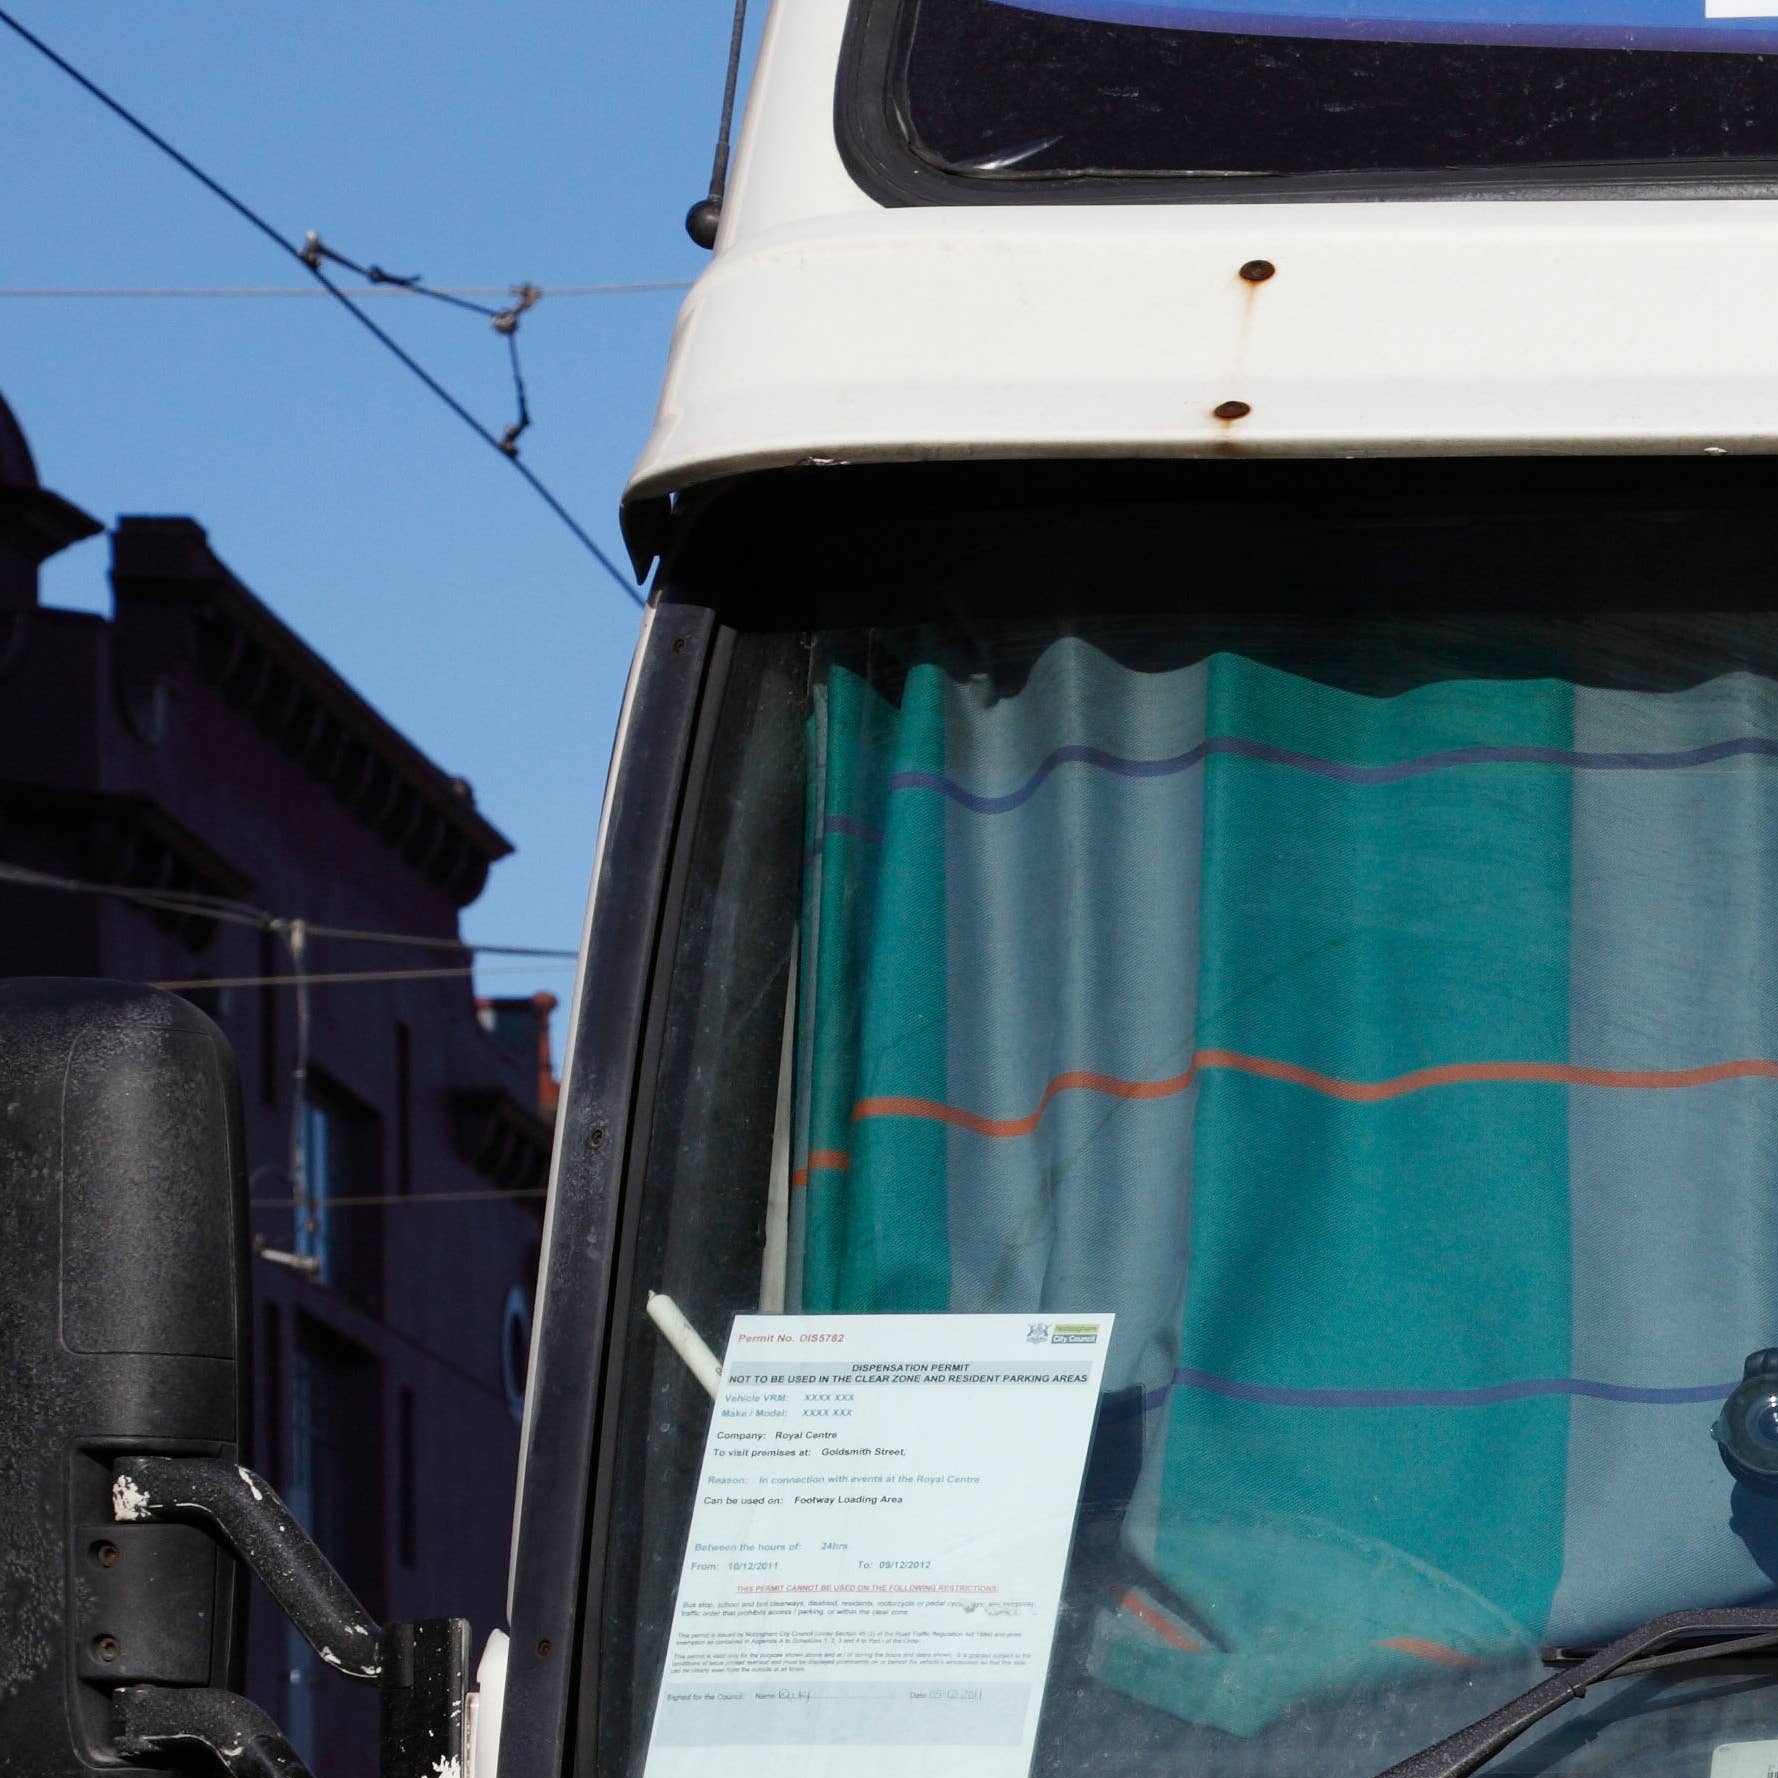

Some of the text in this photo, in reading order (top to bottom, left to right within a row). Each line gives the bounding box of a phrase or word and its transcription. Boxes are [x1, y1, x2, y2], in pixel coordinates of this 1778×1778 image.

[738, 1333, 774, 1343] Permit
[1053, 1334, 1096, 1343] City Council
[852, 1363, 970, 1372] DISPENSATION PERMIT
[729, 1375, 1088, 1384] NOT TO BE USED IN THE CLEAR ZONE AND RESIDENT PARKING AREAS
[716, 1431, 838, 1441] Company: Royal Centre
[713, 1448, 725, 1458] To
[729, 1448, 749, 1458] visit
[751, 1448, 796, 1458] premises
[821, 1448, 872, 1458] Goldsmith
[760, 1475, 768, 1484] In
[771, 1475, 825, 1484] connection
[828, 1475, 848, 1484] with
[850, 1475, 882, 1484] events
[886, 1475, 896, 1484] at
[898, 1475, 914, 1484] the
[917, 1475, 944, 1484] Royal
[947, 1475, 980, 1484] Centre
[704, 1496, 723, 1505] Can
[726, 1496, 738, 1505] be
[741, 1496, 765, 1505] used
[794, 1496, 835, 1505] Footway
[838, 1496, 878, 1505] Loading
[880, 1496, 904, 1505] Area
[694, 1543, 737, 1551] Between
[739, 1543, 755, 1551] the
[758, 1543, 786, 1551] hours
[857, 1561, 873, 1570] To:
[737, 1584, 754, 1592] THIS
[756, 1584, 784, 1592] PERMIT
[786, 1584, 818, 1592] CANNOT
[821, 1584, 832, 1592] BE
[834, 1584, 855, 1592] USED
[857, 1584, 870, 1592] ON
[871, 1584, 889, 1592] THE
[889, 1584, 935, 1592] FOLLOWING
